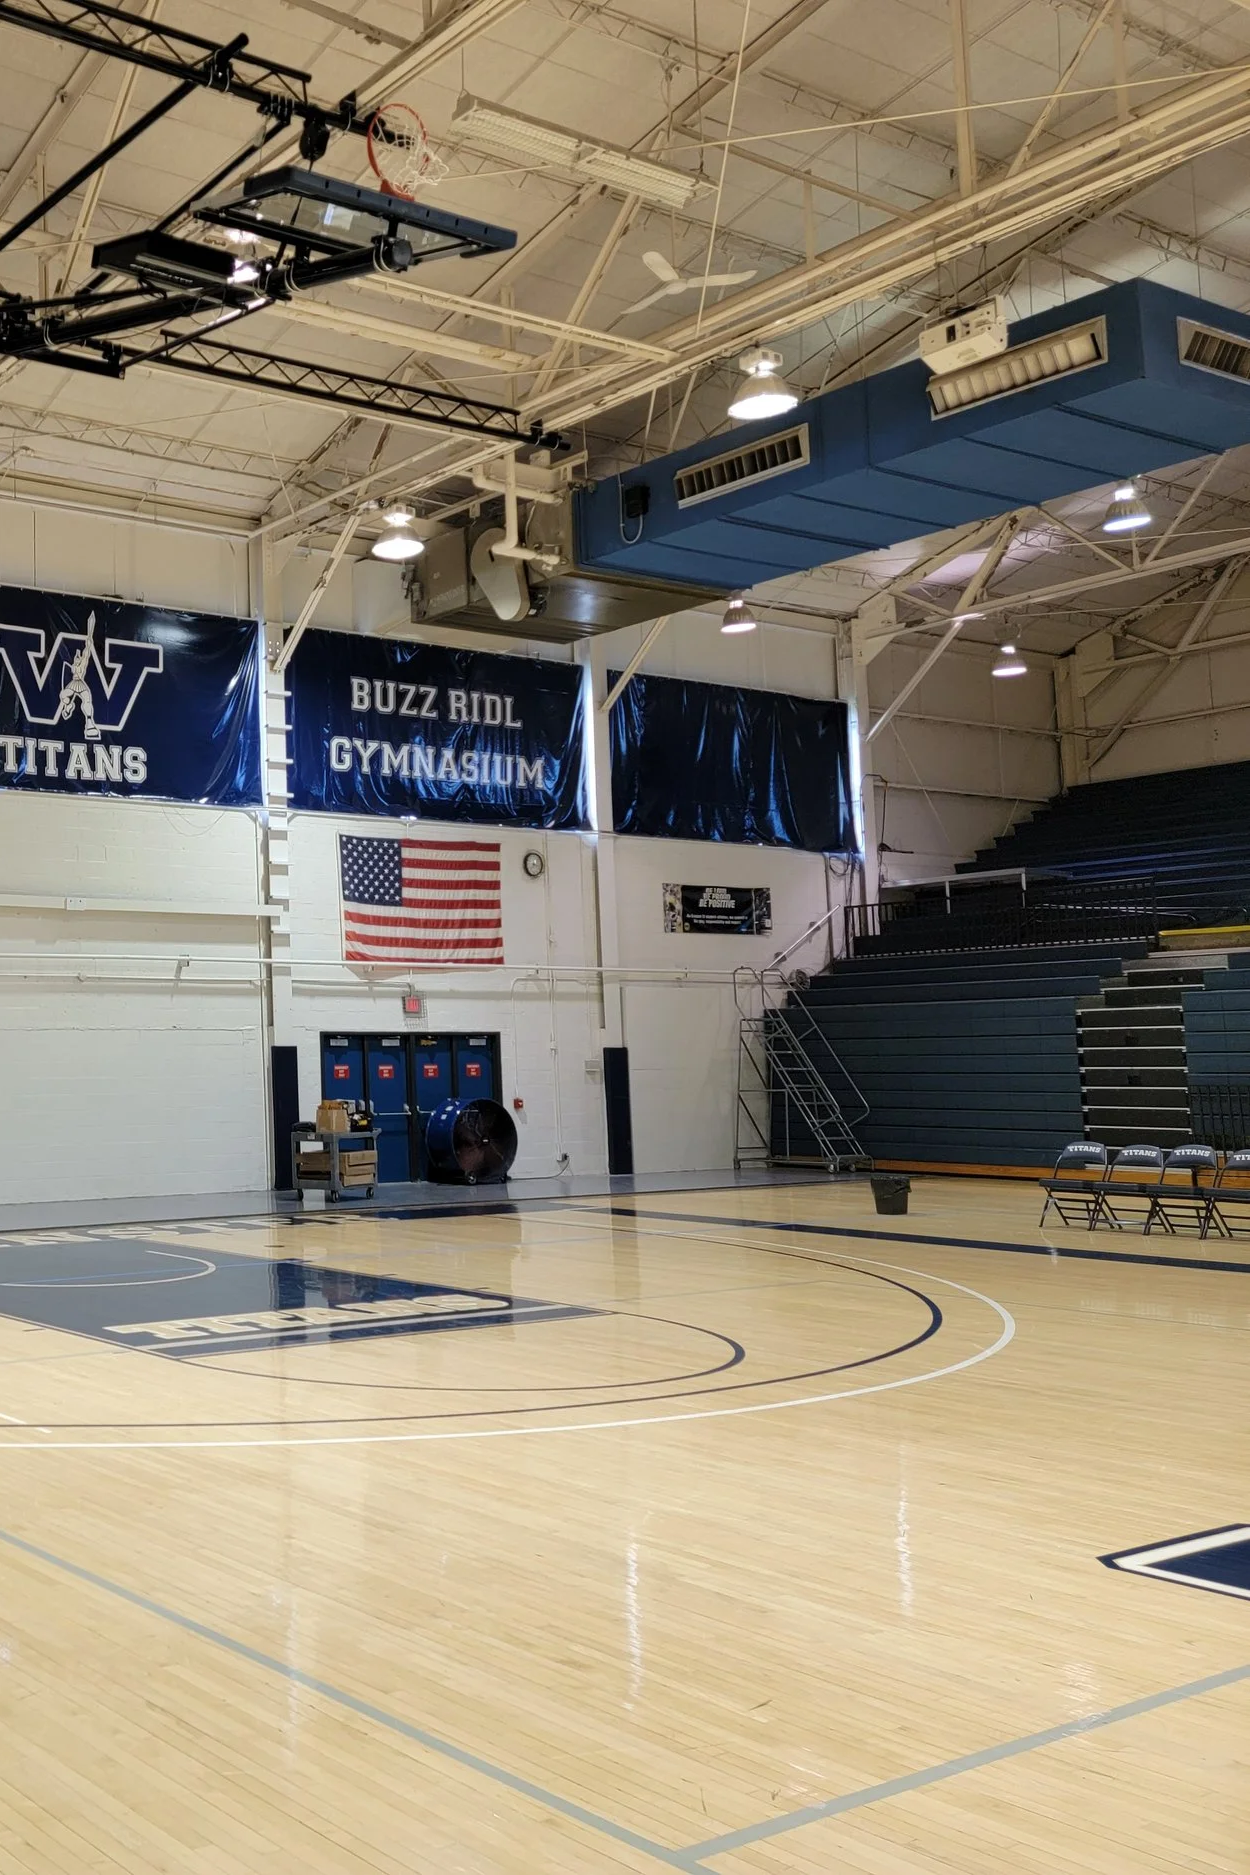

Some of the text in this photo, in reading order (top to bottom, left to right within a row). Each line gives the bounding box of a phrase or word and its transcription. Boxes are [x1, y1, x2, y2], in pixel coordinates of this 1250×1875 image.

[350, 676, 523, 729] BUZZ RIDL
[329, 736, 546, 789] GYMNASIUM
[1068, 1145, 1101, 1154] TITANS
[1122, 1149, 1157, 1158] TITANS
[1174, 1149, 1210, 1158] TITANS
[102, 1294, 511, 1340] TITANS
